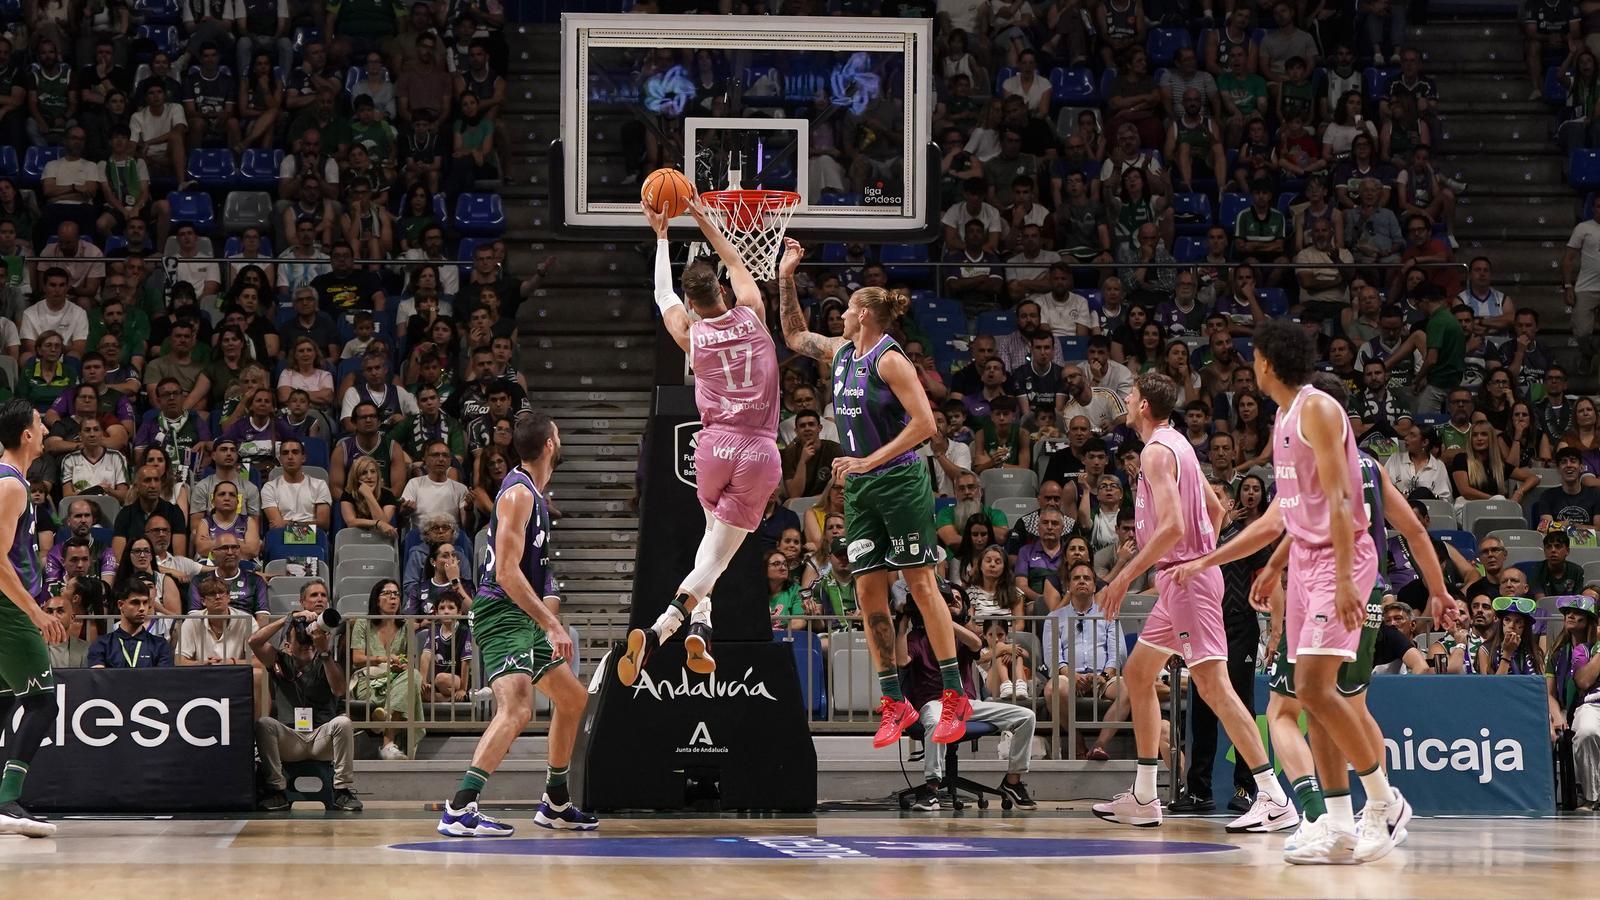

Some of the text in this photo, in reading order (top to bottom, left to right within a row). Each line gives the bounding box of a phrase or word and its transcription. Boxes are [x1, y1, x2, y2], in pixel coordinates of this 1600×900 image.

[864, 186, 882, 196] liga
[864, 195, 902, 204] endesa
[697, 320, 757, 349] DEKKER
[717, 343, 754, 391] 17
[846, 429, 856, 451] 1
[632, 666, 778, 701] Andalucía
[0, 683, 231, 748] desa
[1384, 727, 1524, 784] nicaja
